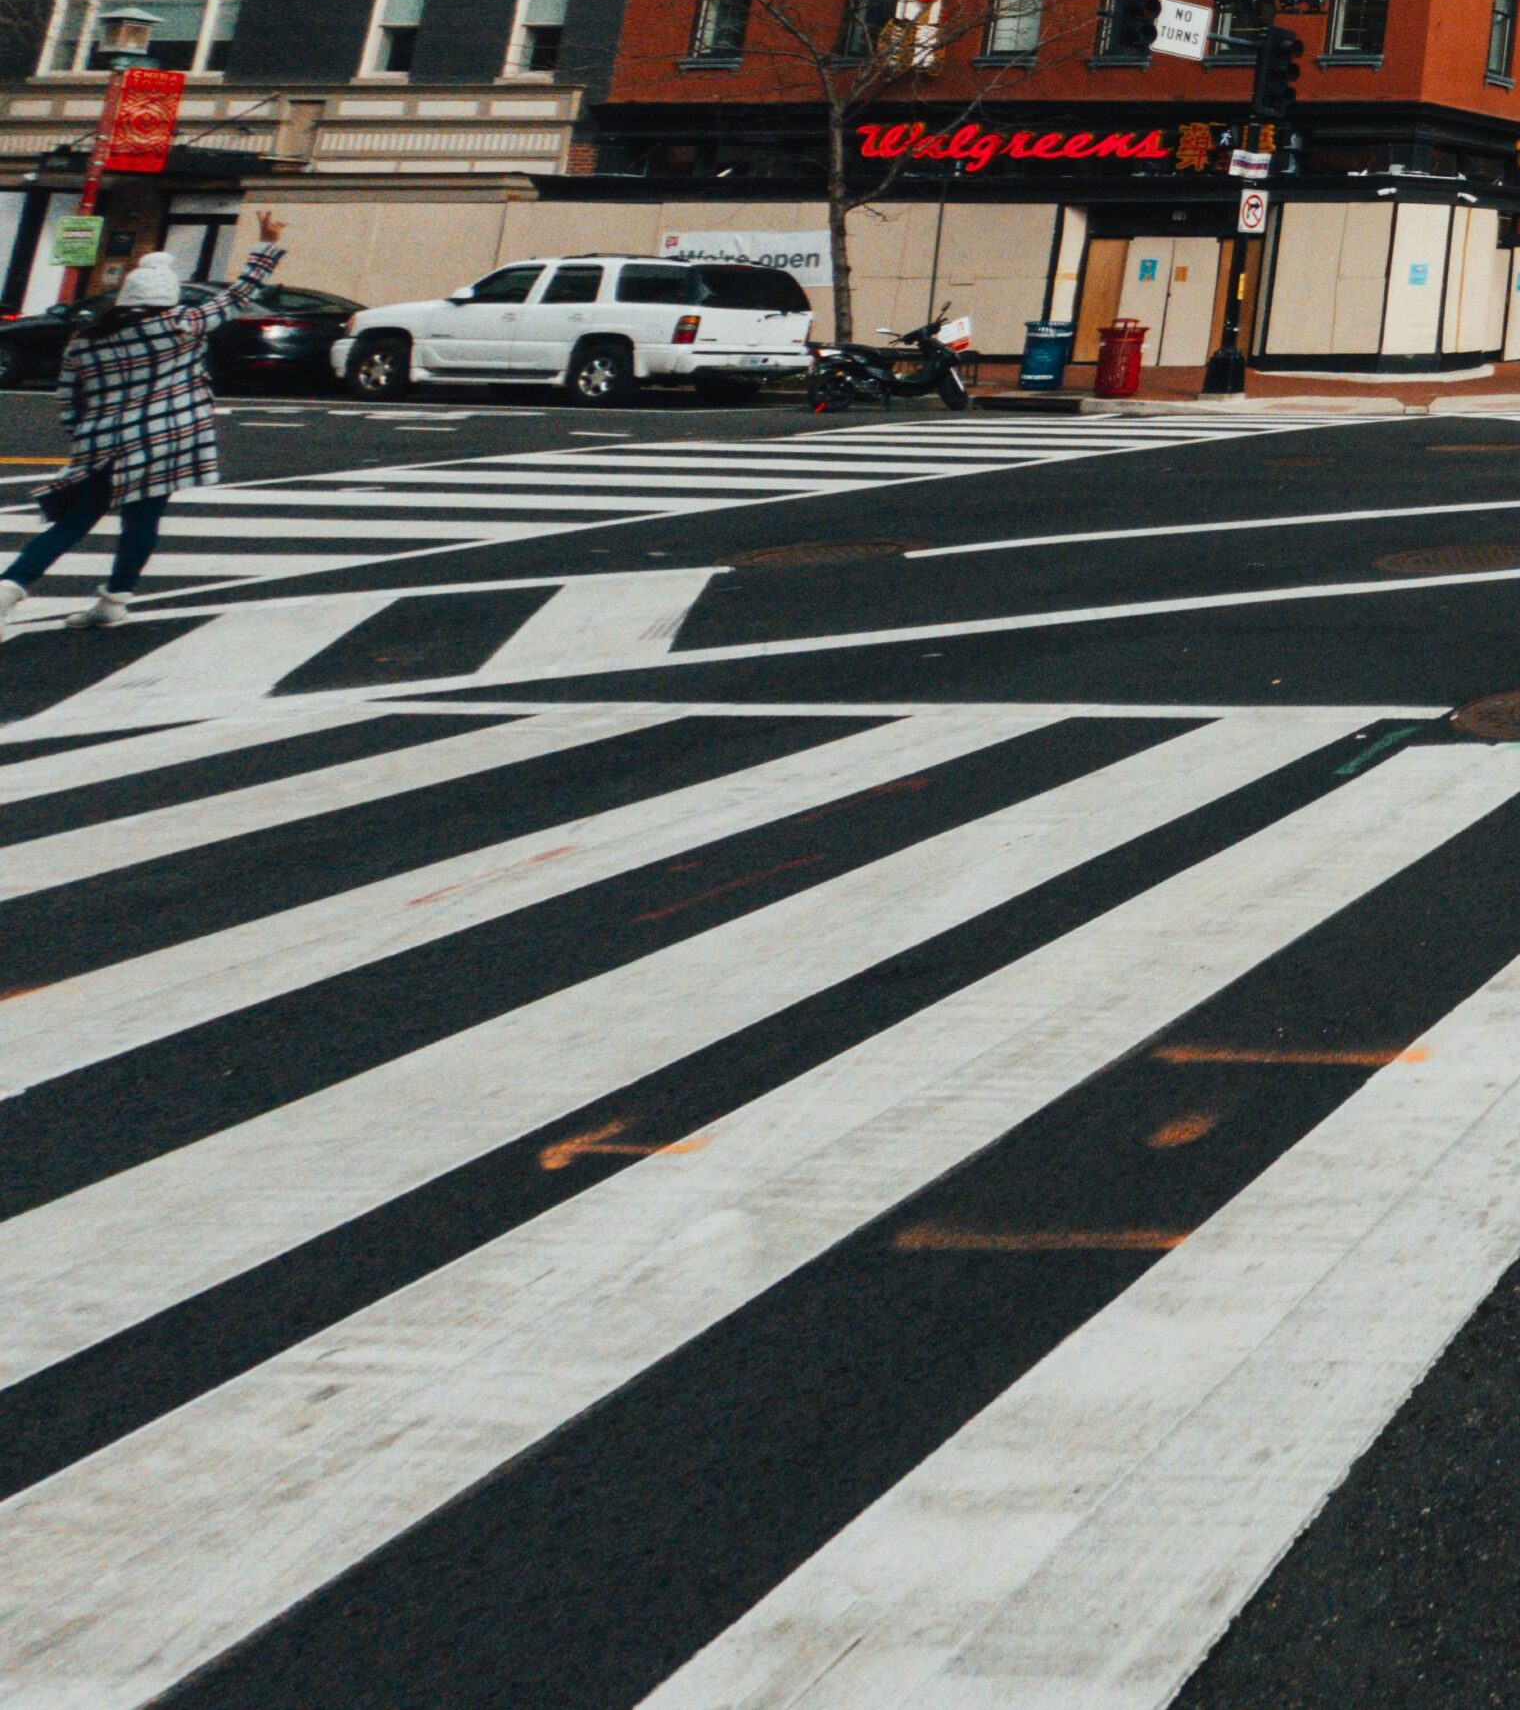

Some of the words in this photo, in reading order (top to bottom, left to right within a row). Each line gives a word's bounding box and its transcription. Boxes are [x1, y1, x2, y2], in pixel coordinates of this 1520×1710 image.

[1175, 8, 1193, 22] NO
[1161, 25, 1199, 45] TURNS
[856, 122, 1170, 172] Walgreens
[758, 252, 820, 268] open
